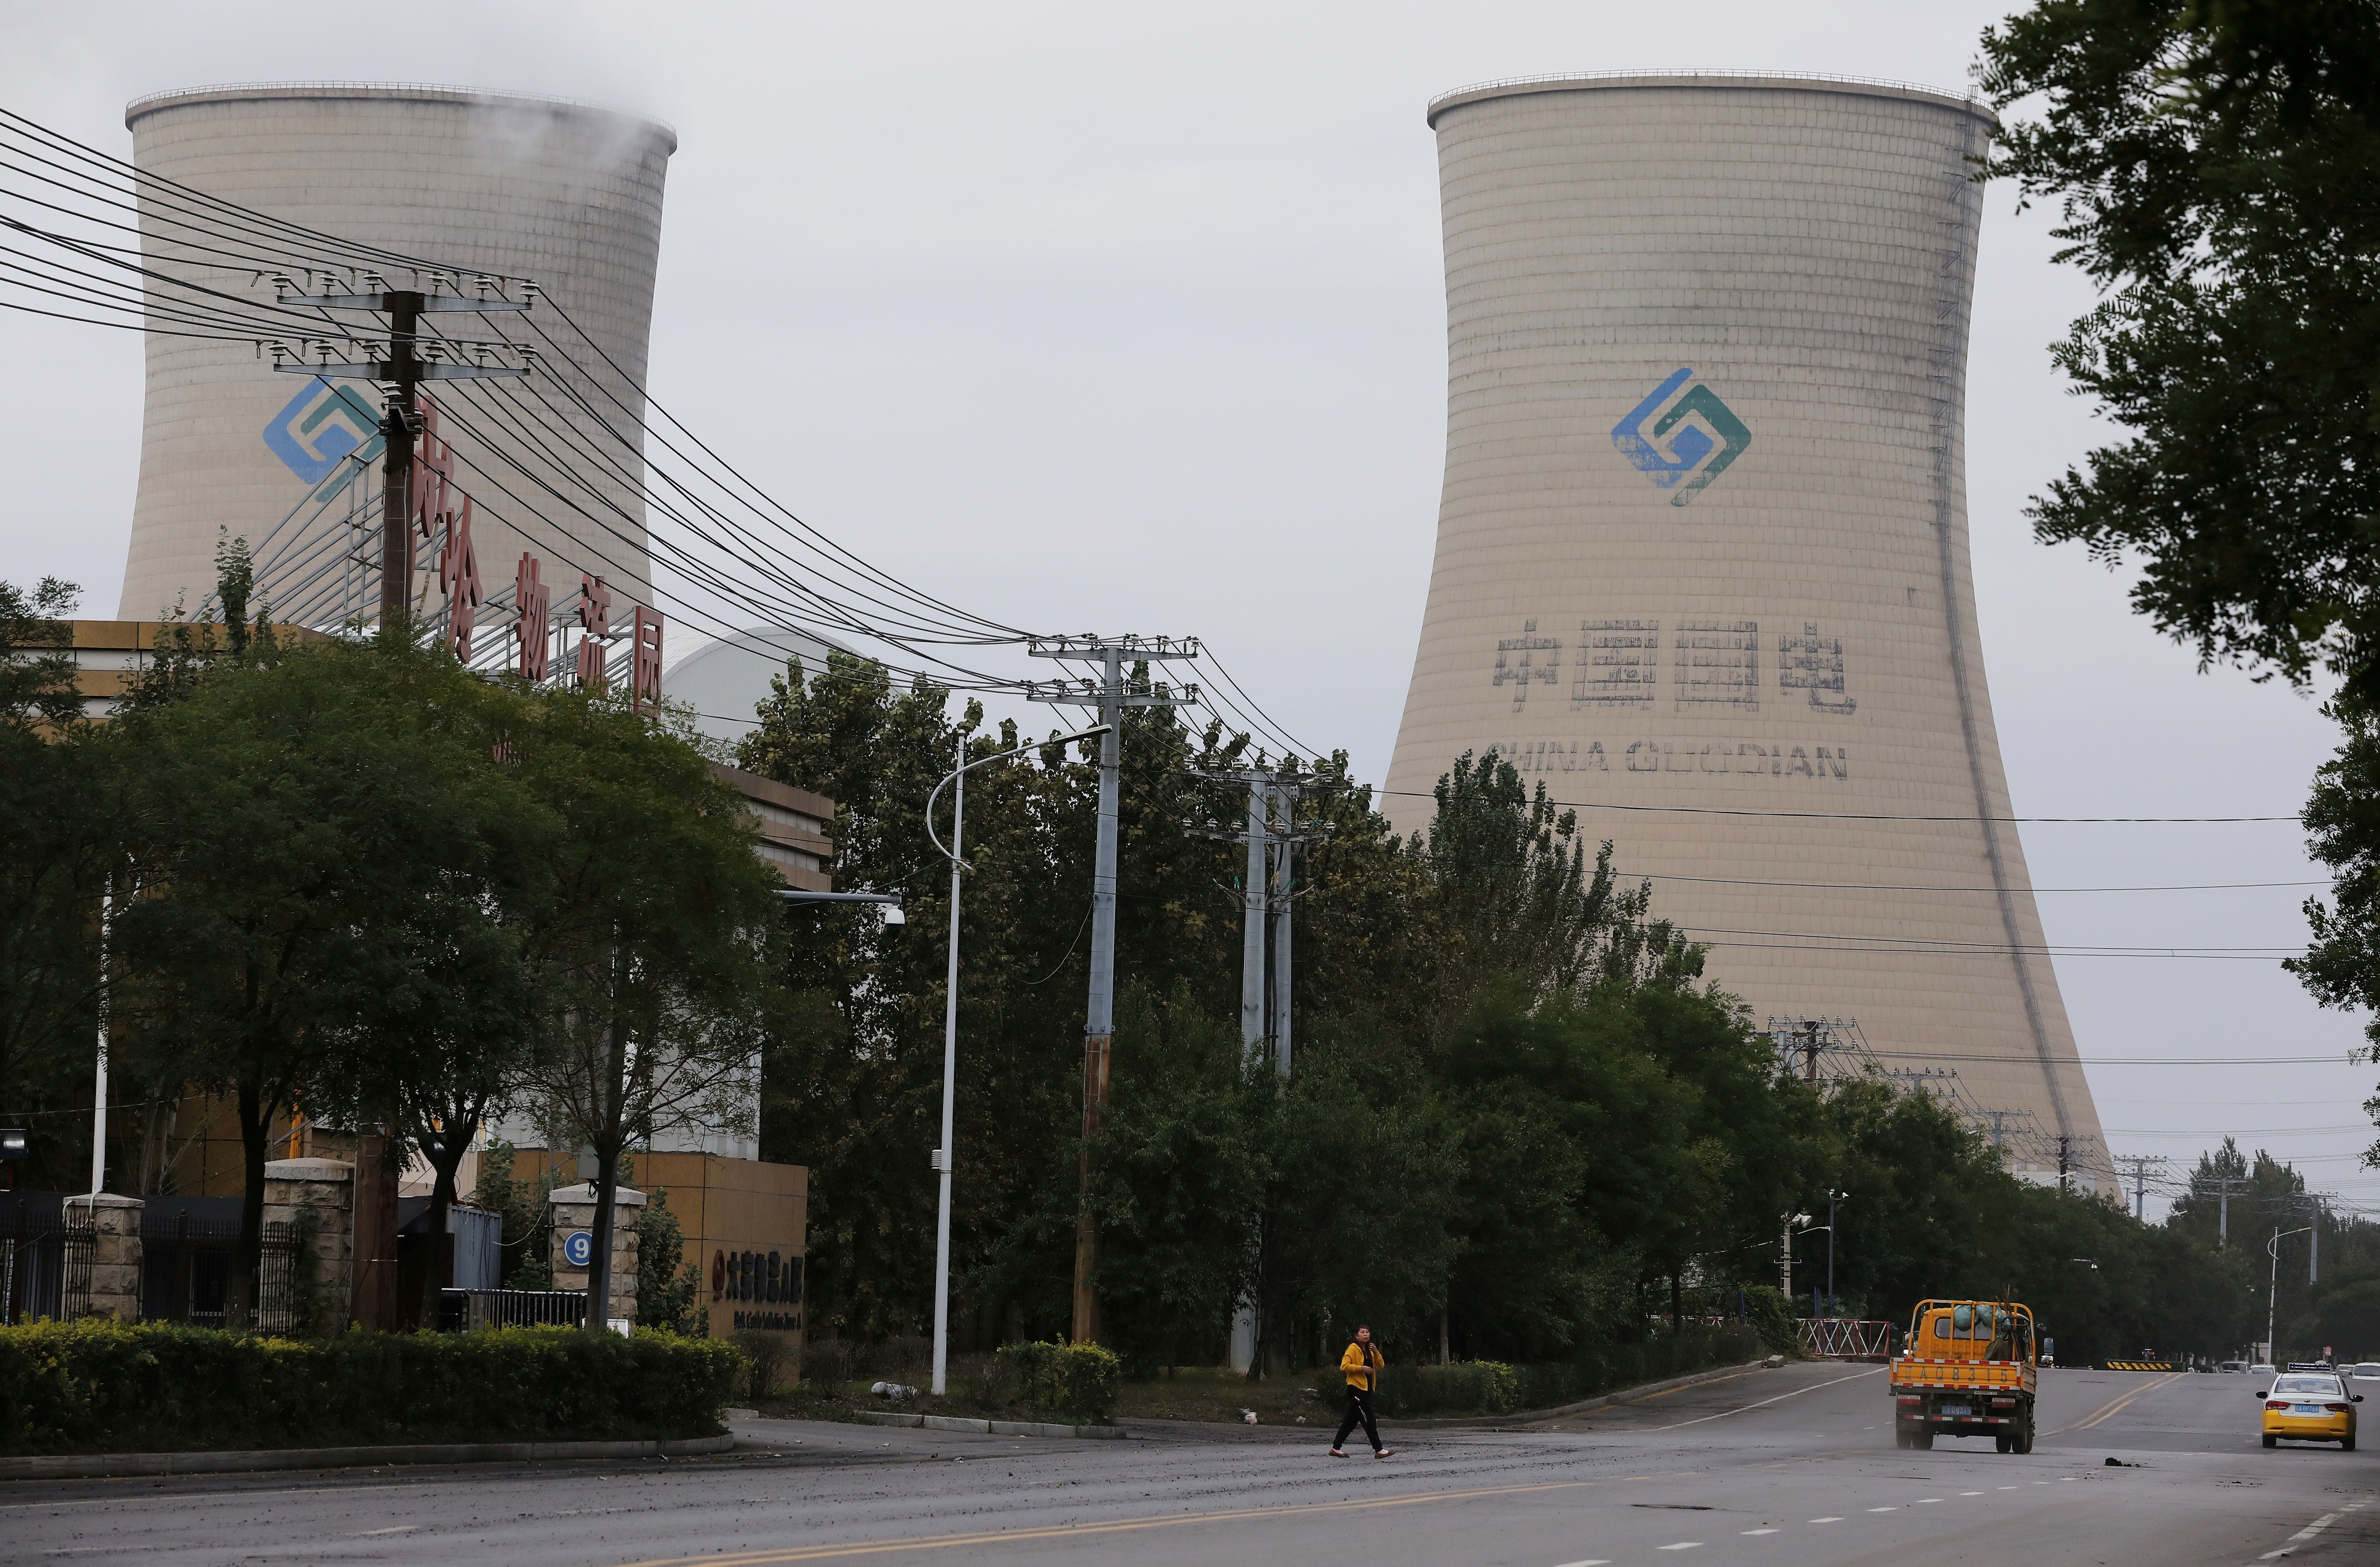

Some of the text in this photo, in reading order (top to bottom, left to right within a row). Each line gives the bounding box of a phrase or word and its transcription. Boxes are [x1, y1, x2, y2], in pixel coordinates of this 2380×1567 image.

[1493, 618, 1857, 715] 中国国电
[1626, 741, 1848, 781] GUODIAN
[574, 1238, 589, 1259] 9
